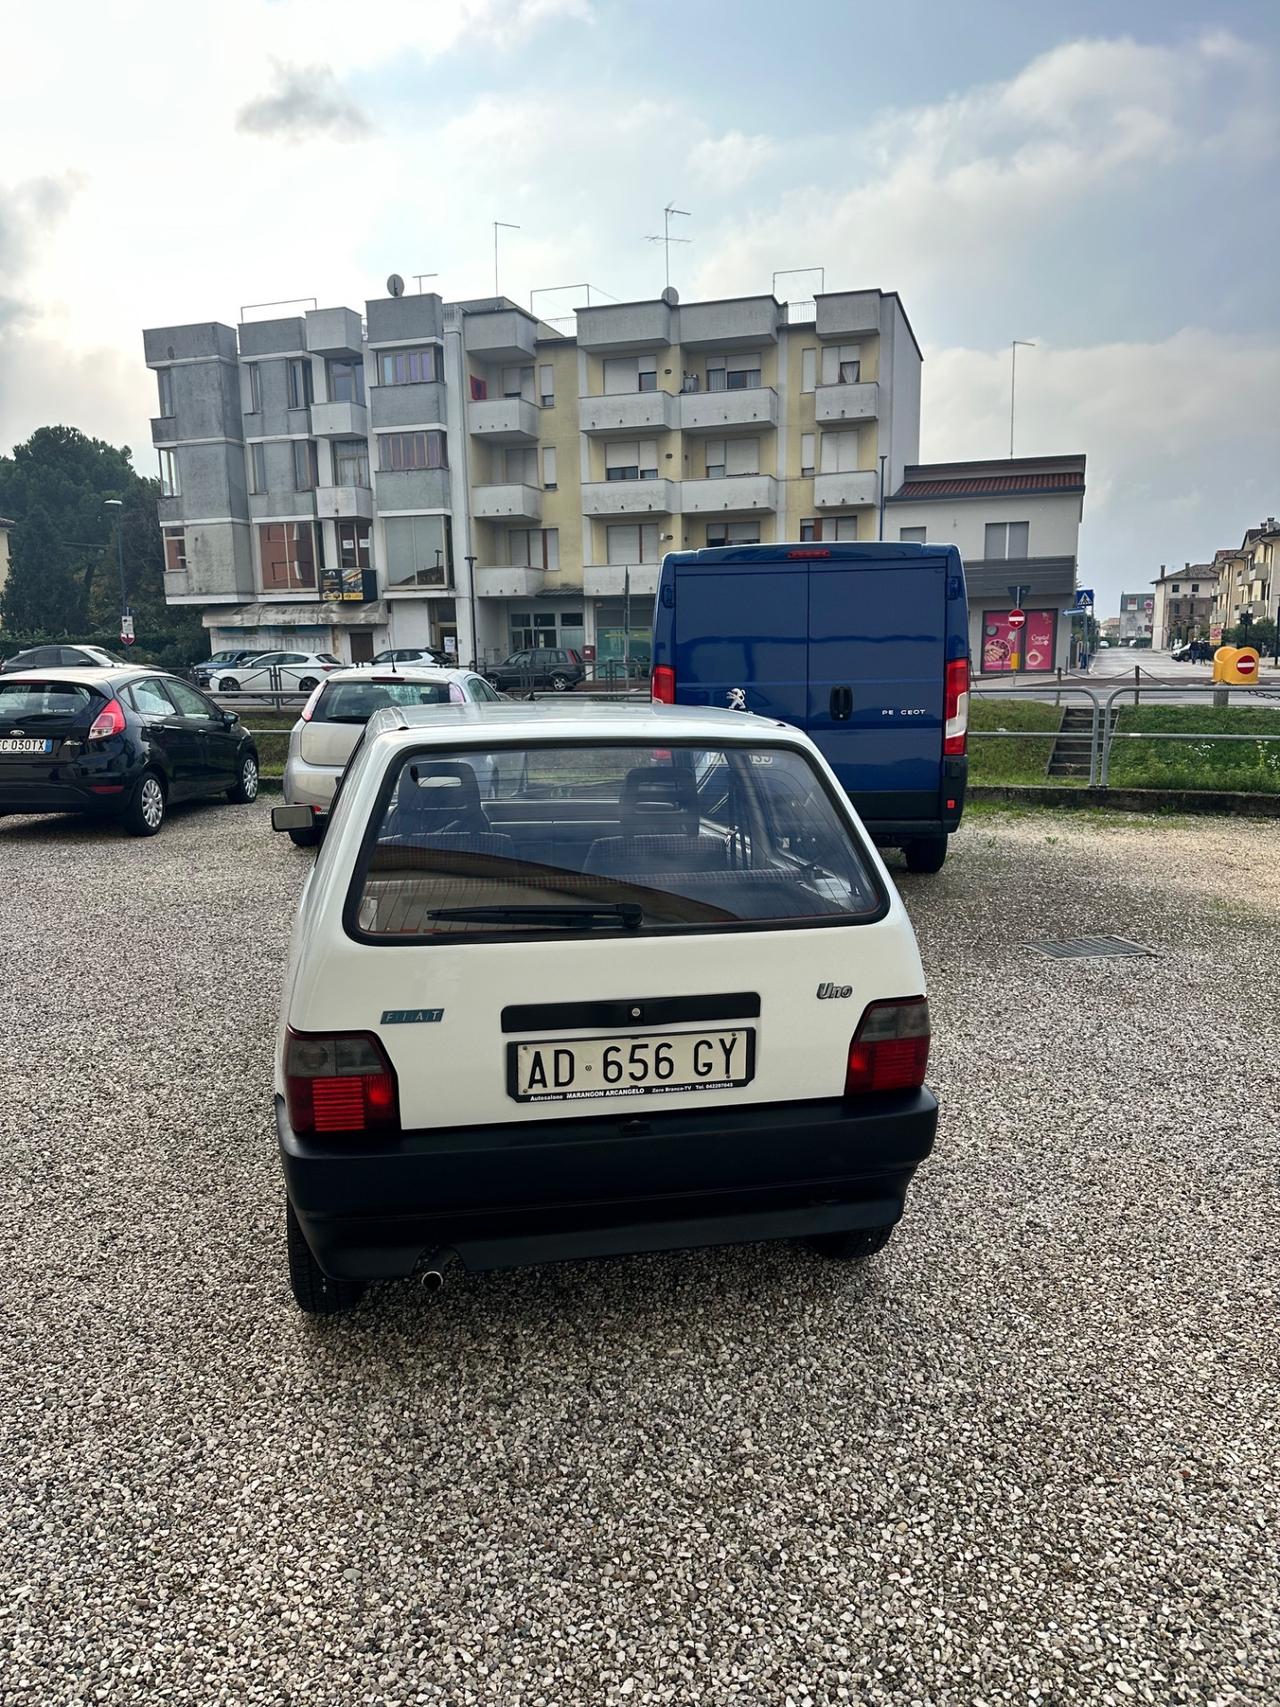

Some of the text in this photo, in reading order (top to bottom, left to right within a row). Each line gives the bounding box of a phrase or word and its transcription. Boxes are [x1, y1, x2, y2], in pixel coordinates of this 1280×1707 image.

[0, 739, 8, 751] C
[816, 982, 853, 1000] Uno
[385, 1010, 441, 1022] FIAT
[527, 1036, 738, 1089] AD 656 GY
[530, 1094, 563, 1102] Autosalone
[566, 1090, 604, 1099] MARANGON
[605, 1087, 645, 1097] ARCANGELO
